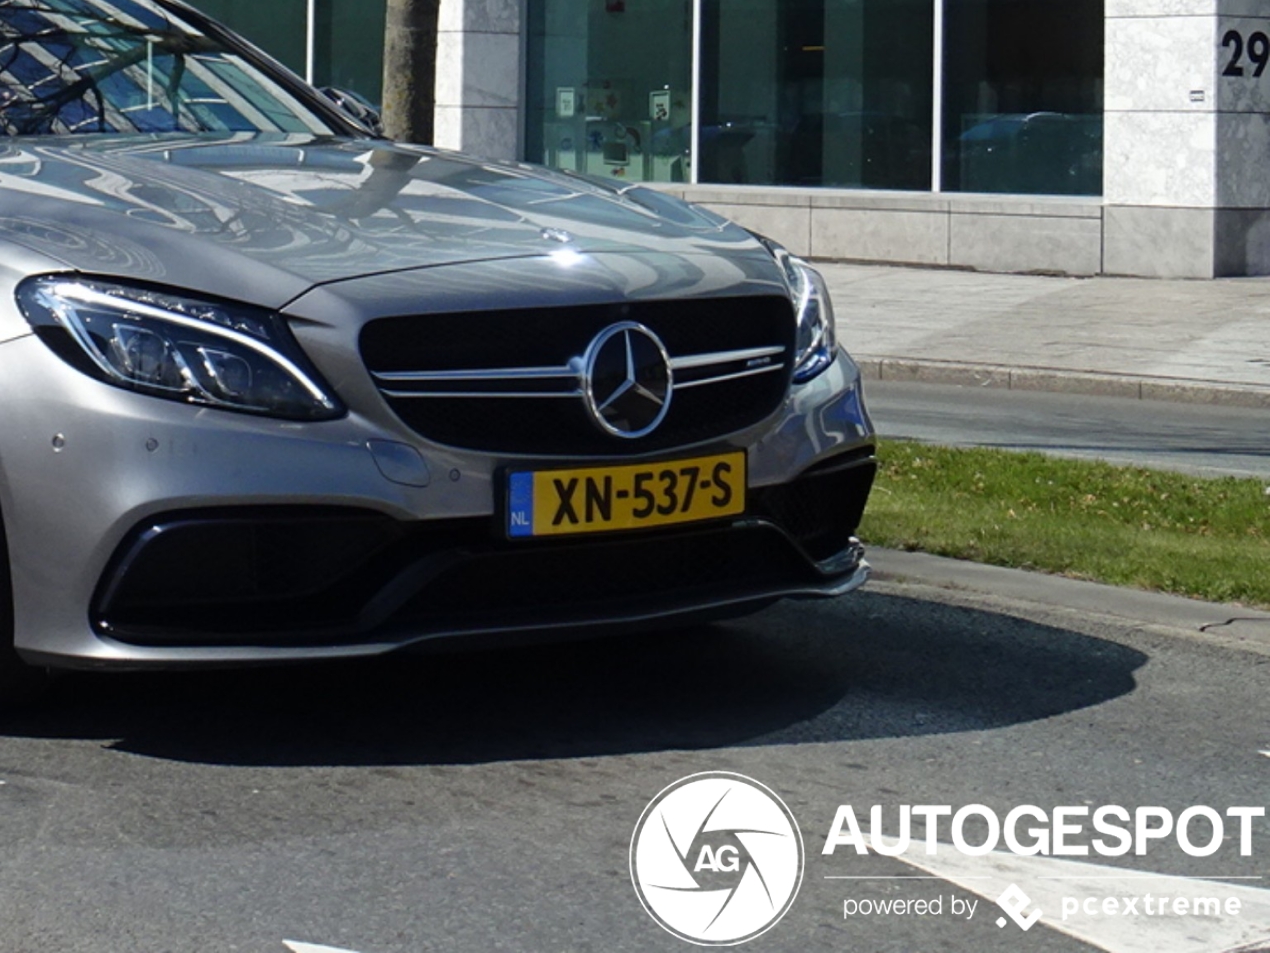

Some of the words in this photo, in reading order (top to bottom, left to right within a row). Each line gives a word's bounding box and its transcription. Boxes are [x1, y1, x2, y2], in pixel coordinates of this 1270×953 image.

[1222, 30, 1269, 78] 29
[511, 511, 529, 526] NL
[552, 462, 732, 526] XN-537-S
